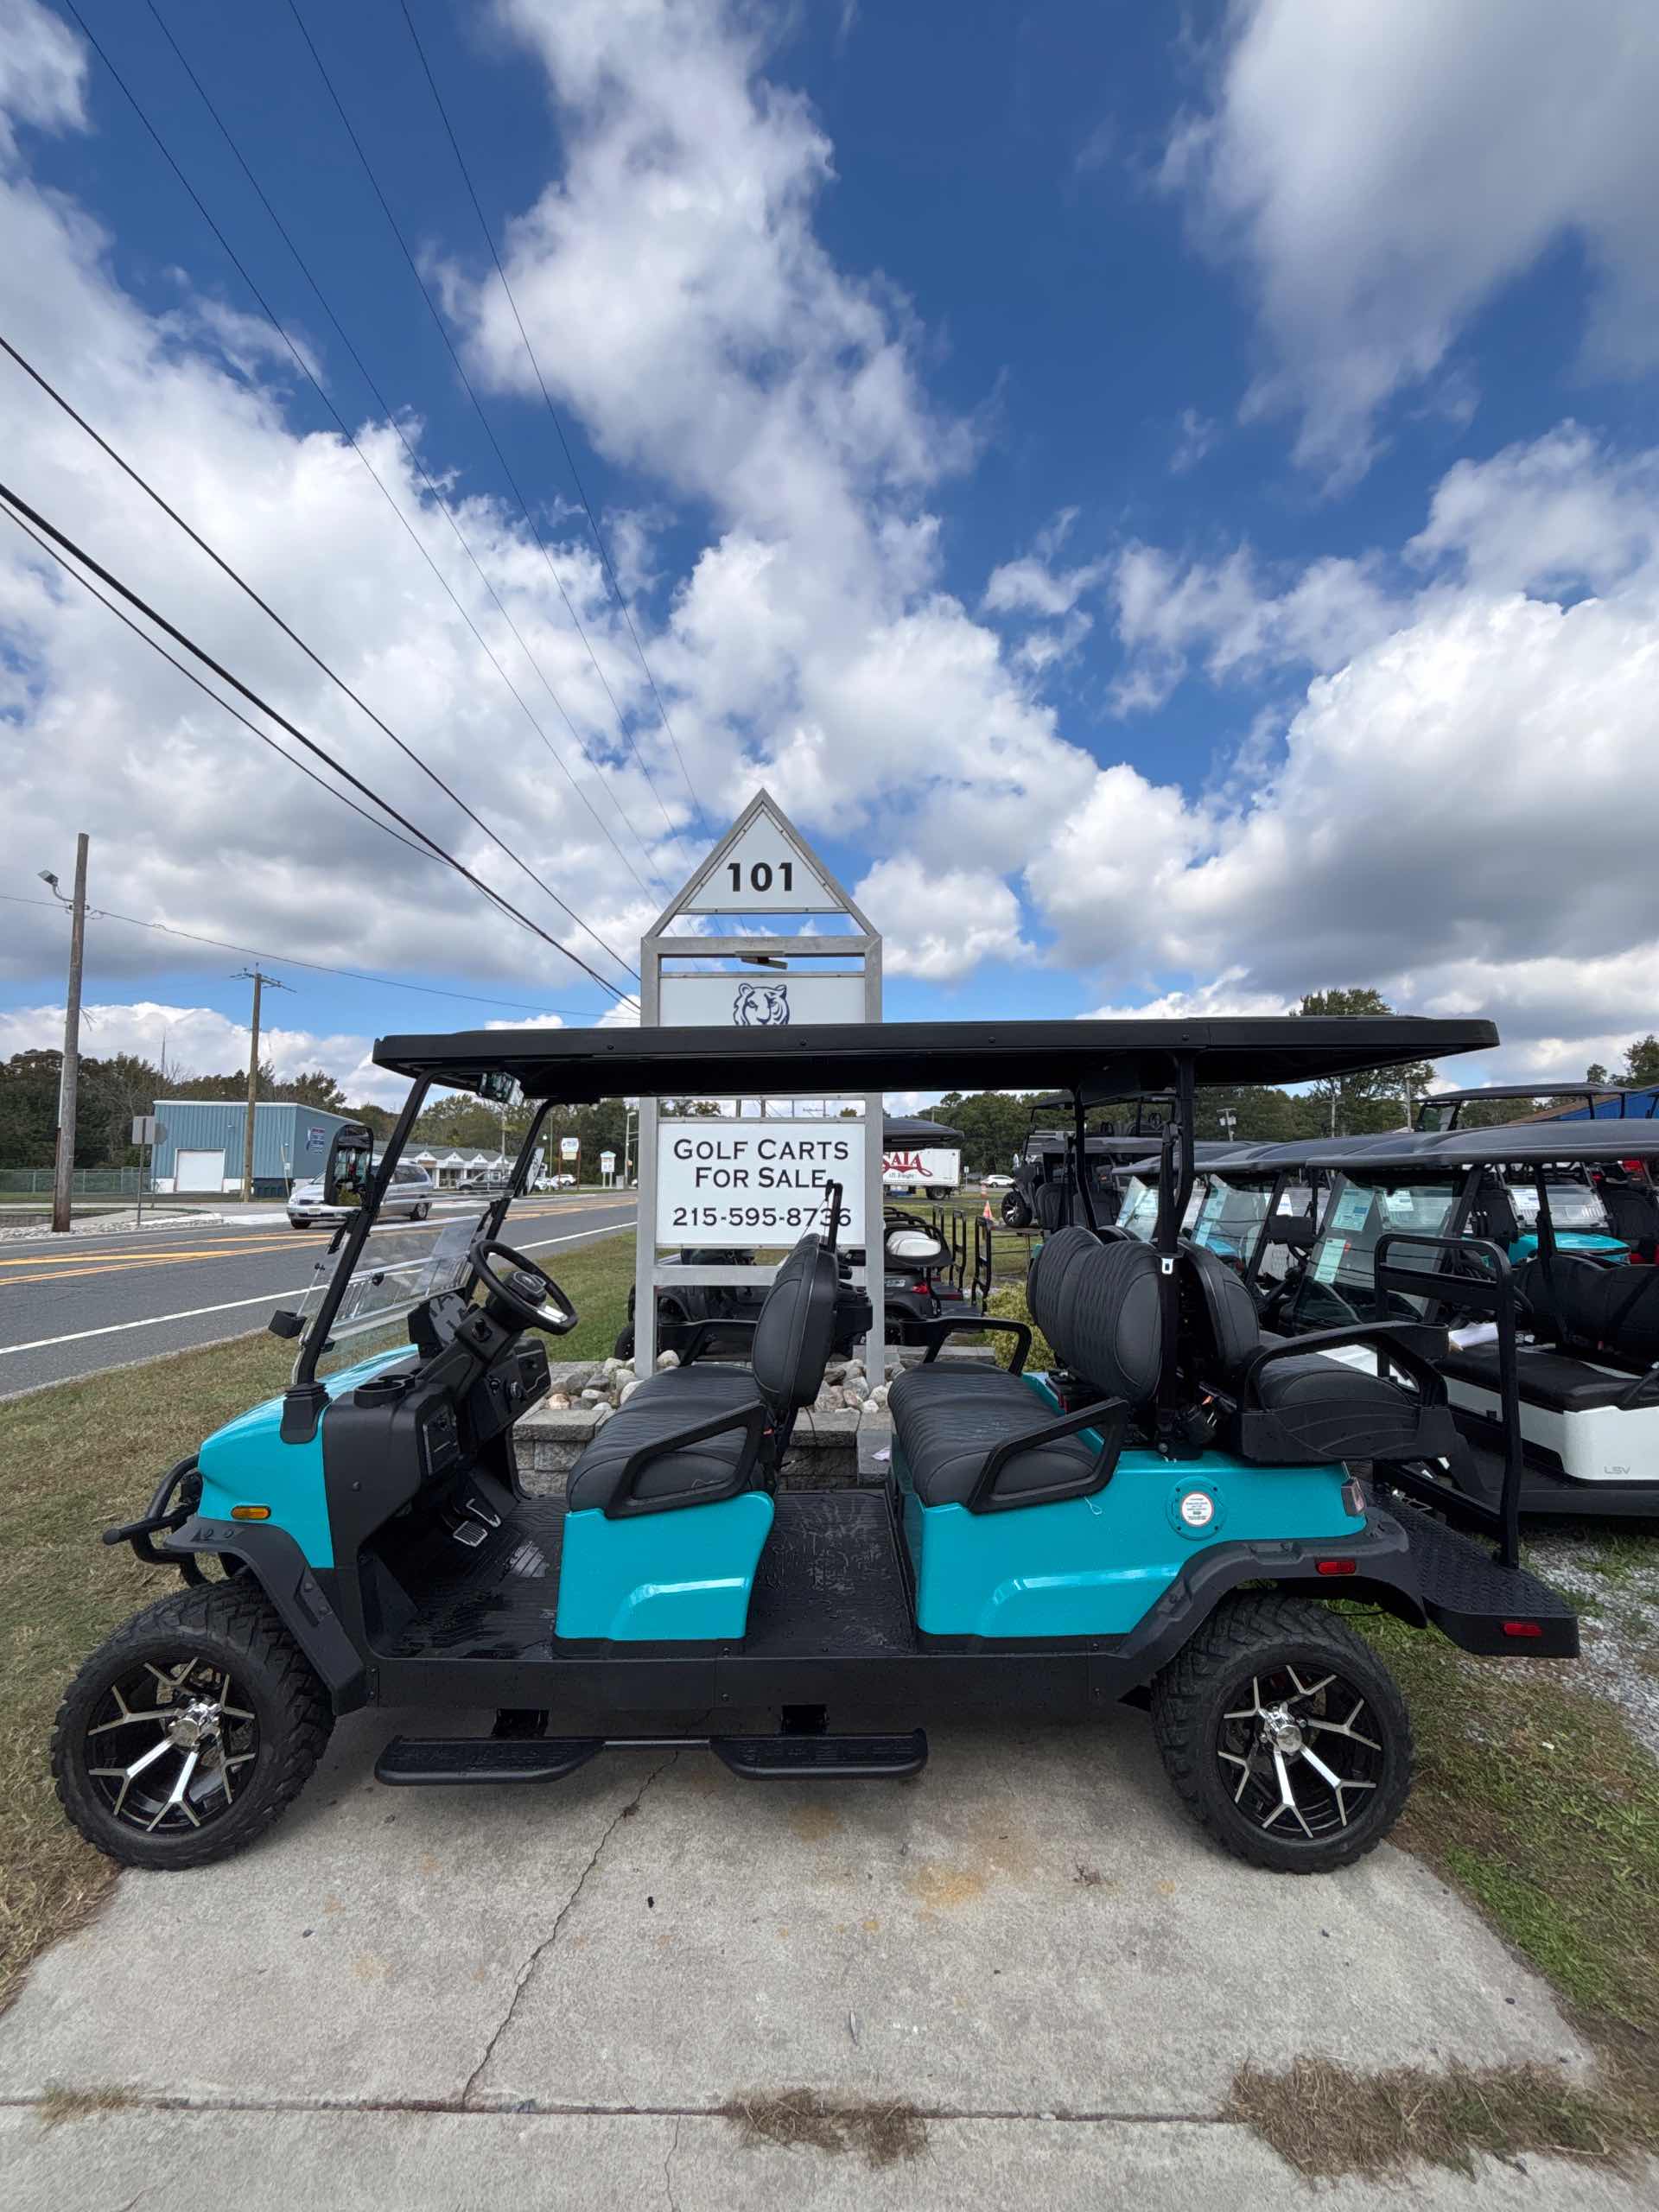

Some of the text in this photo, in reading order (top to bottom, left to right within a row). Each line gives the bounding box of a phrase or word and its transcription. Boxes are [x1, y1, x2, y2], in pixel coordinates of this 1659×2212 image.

[727, 862, 794, 892] 101
[674, 1138, 849, 1160] GOLF CARTS
[696, 1166, 827, 1188] FOR SALE
[673, 1206, 852, 1227] 215-595-8736
[1603, 1465, 1631, 1475] LSV
